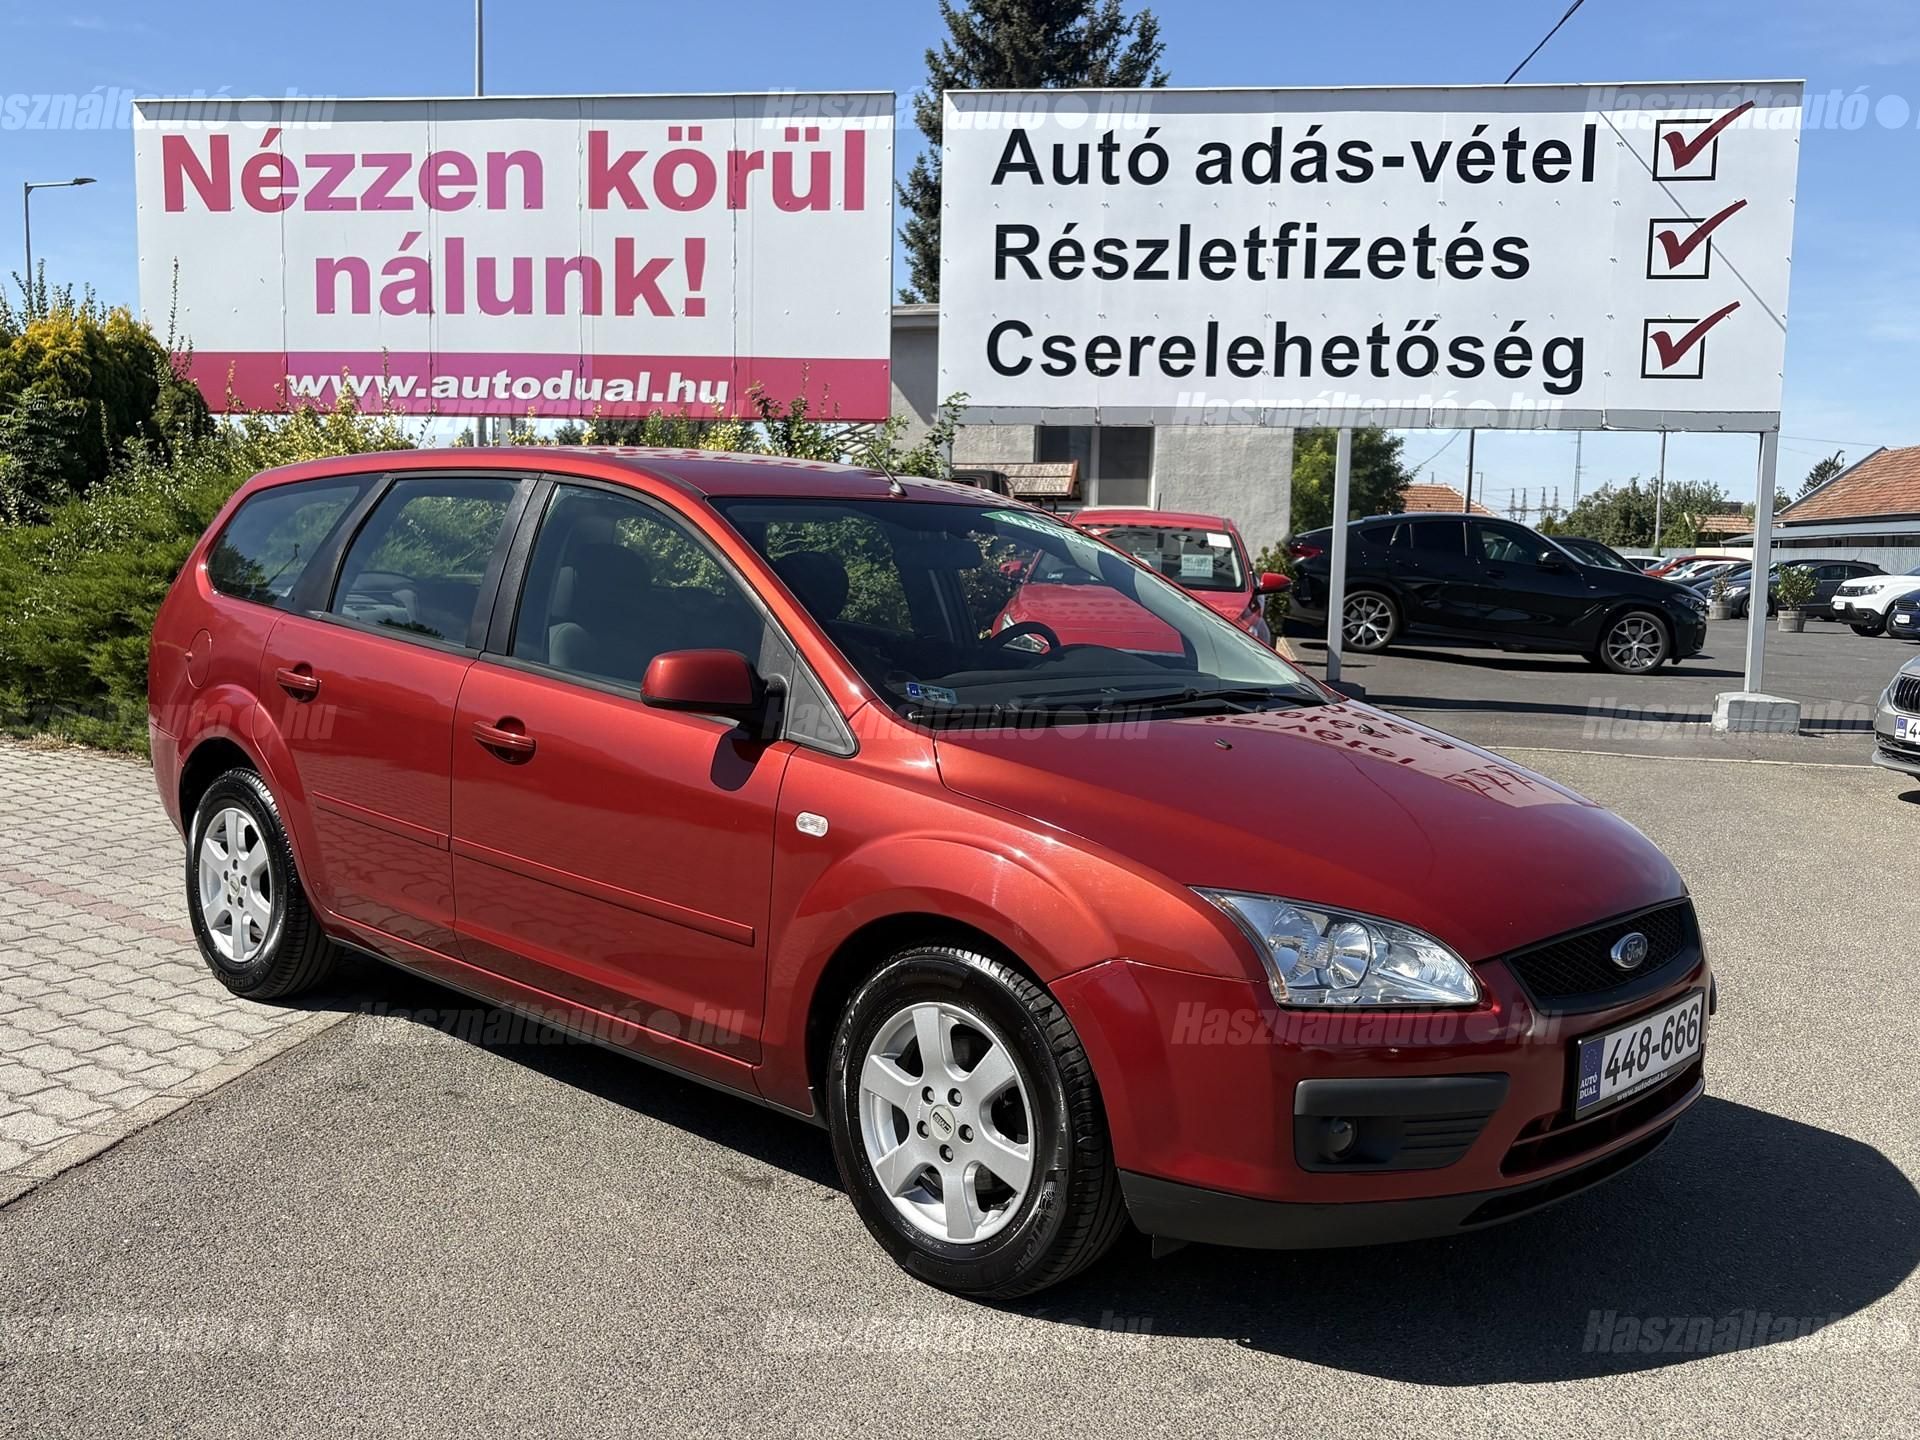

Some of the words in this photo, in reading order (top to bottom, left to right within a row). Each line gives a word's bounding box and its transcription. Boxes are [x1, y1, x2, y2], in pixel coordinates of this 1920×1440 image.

[162, 128, 543, 212] Nézzen
[588, 126, 865, 212] körül
[991, 126, 1169, 186] Autó
[1196, 124, 1598, 185] adás-vétel
[316, 232, 706, 317] nálunk!
[994, 221, 1531, 281] Részletfizetés
[288, 370, 729, 404] www.autodual.hu
[986, 319, 1585, 395] Cserelehetőség
[1604, 1002, 1699, 1086] 448-666
[1579, 1085, 1598, 1100] DUAL
